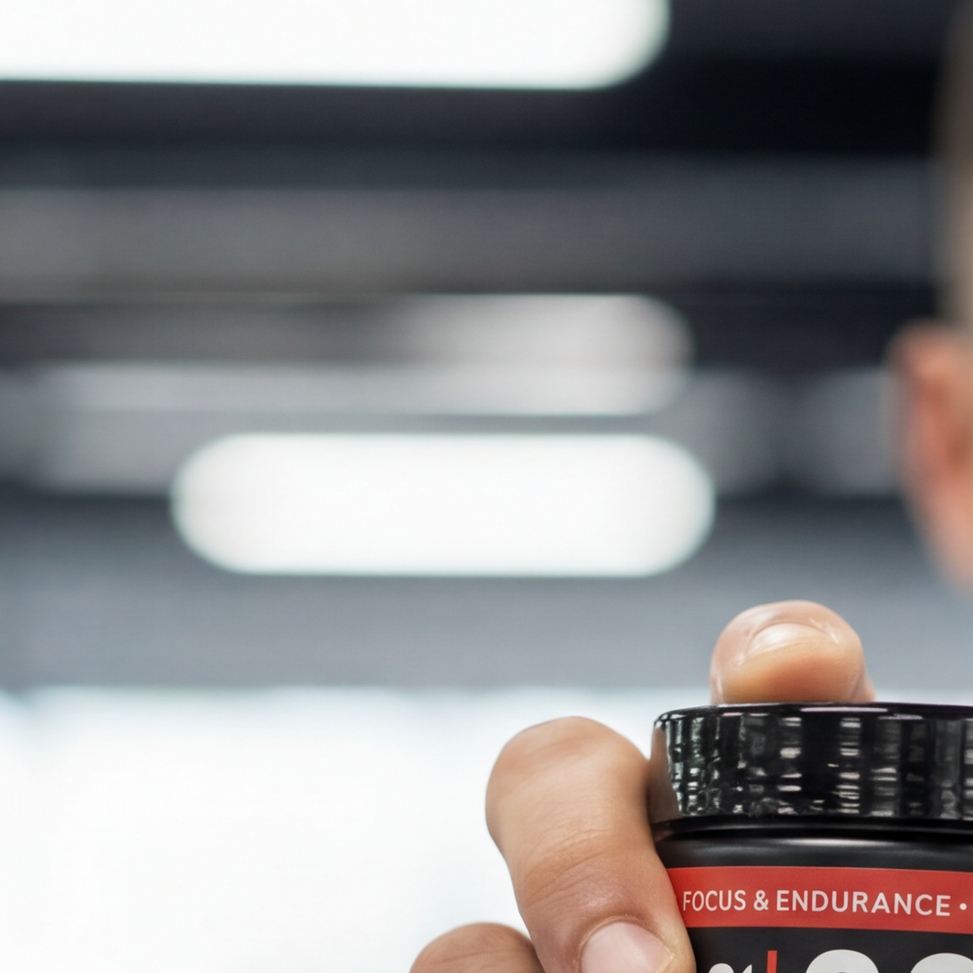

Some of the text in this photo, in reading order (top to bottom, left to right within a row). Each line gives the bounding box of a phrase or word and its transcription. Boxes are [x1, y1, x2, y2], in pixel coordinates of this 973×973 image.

[683, 890, 747, 912] FOCUS
[753, 890, 769, 911] &
[776, 890, 951, 917] ENDURANCE
